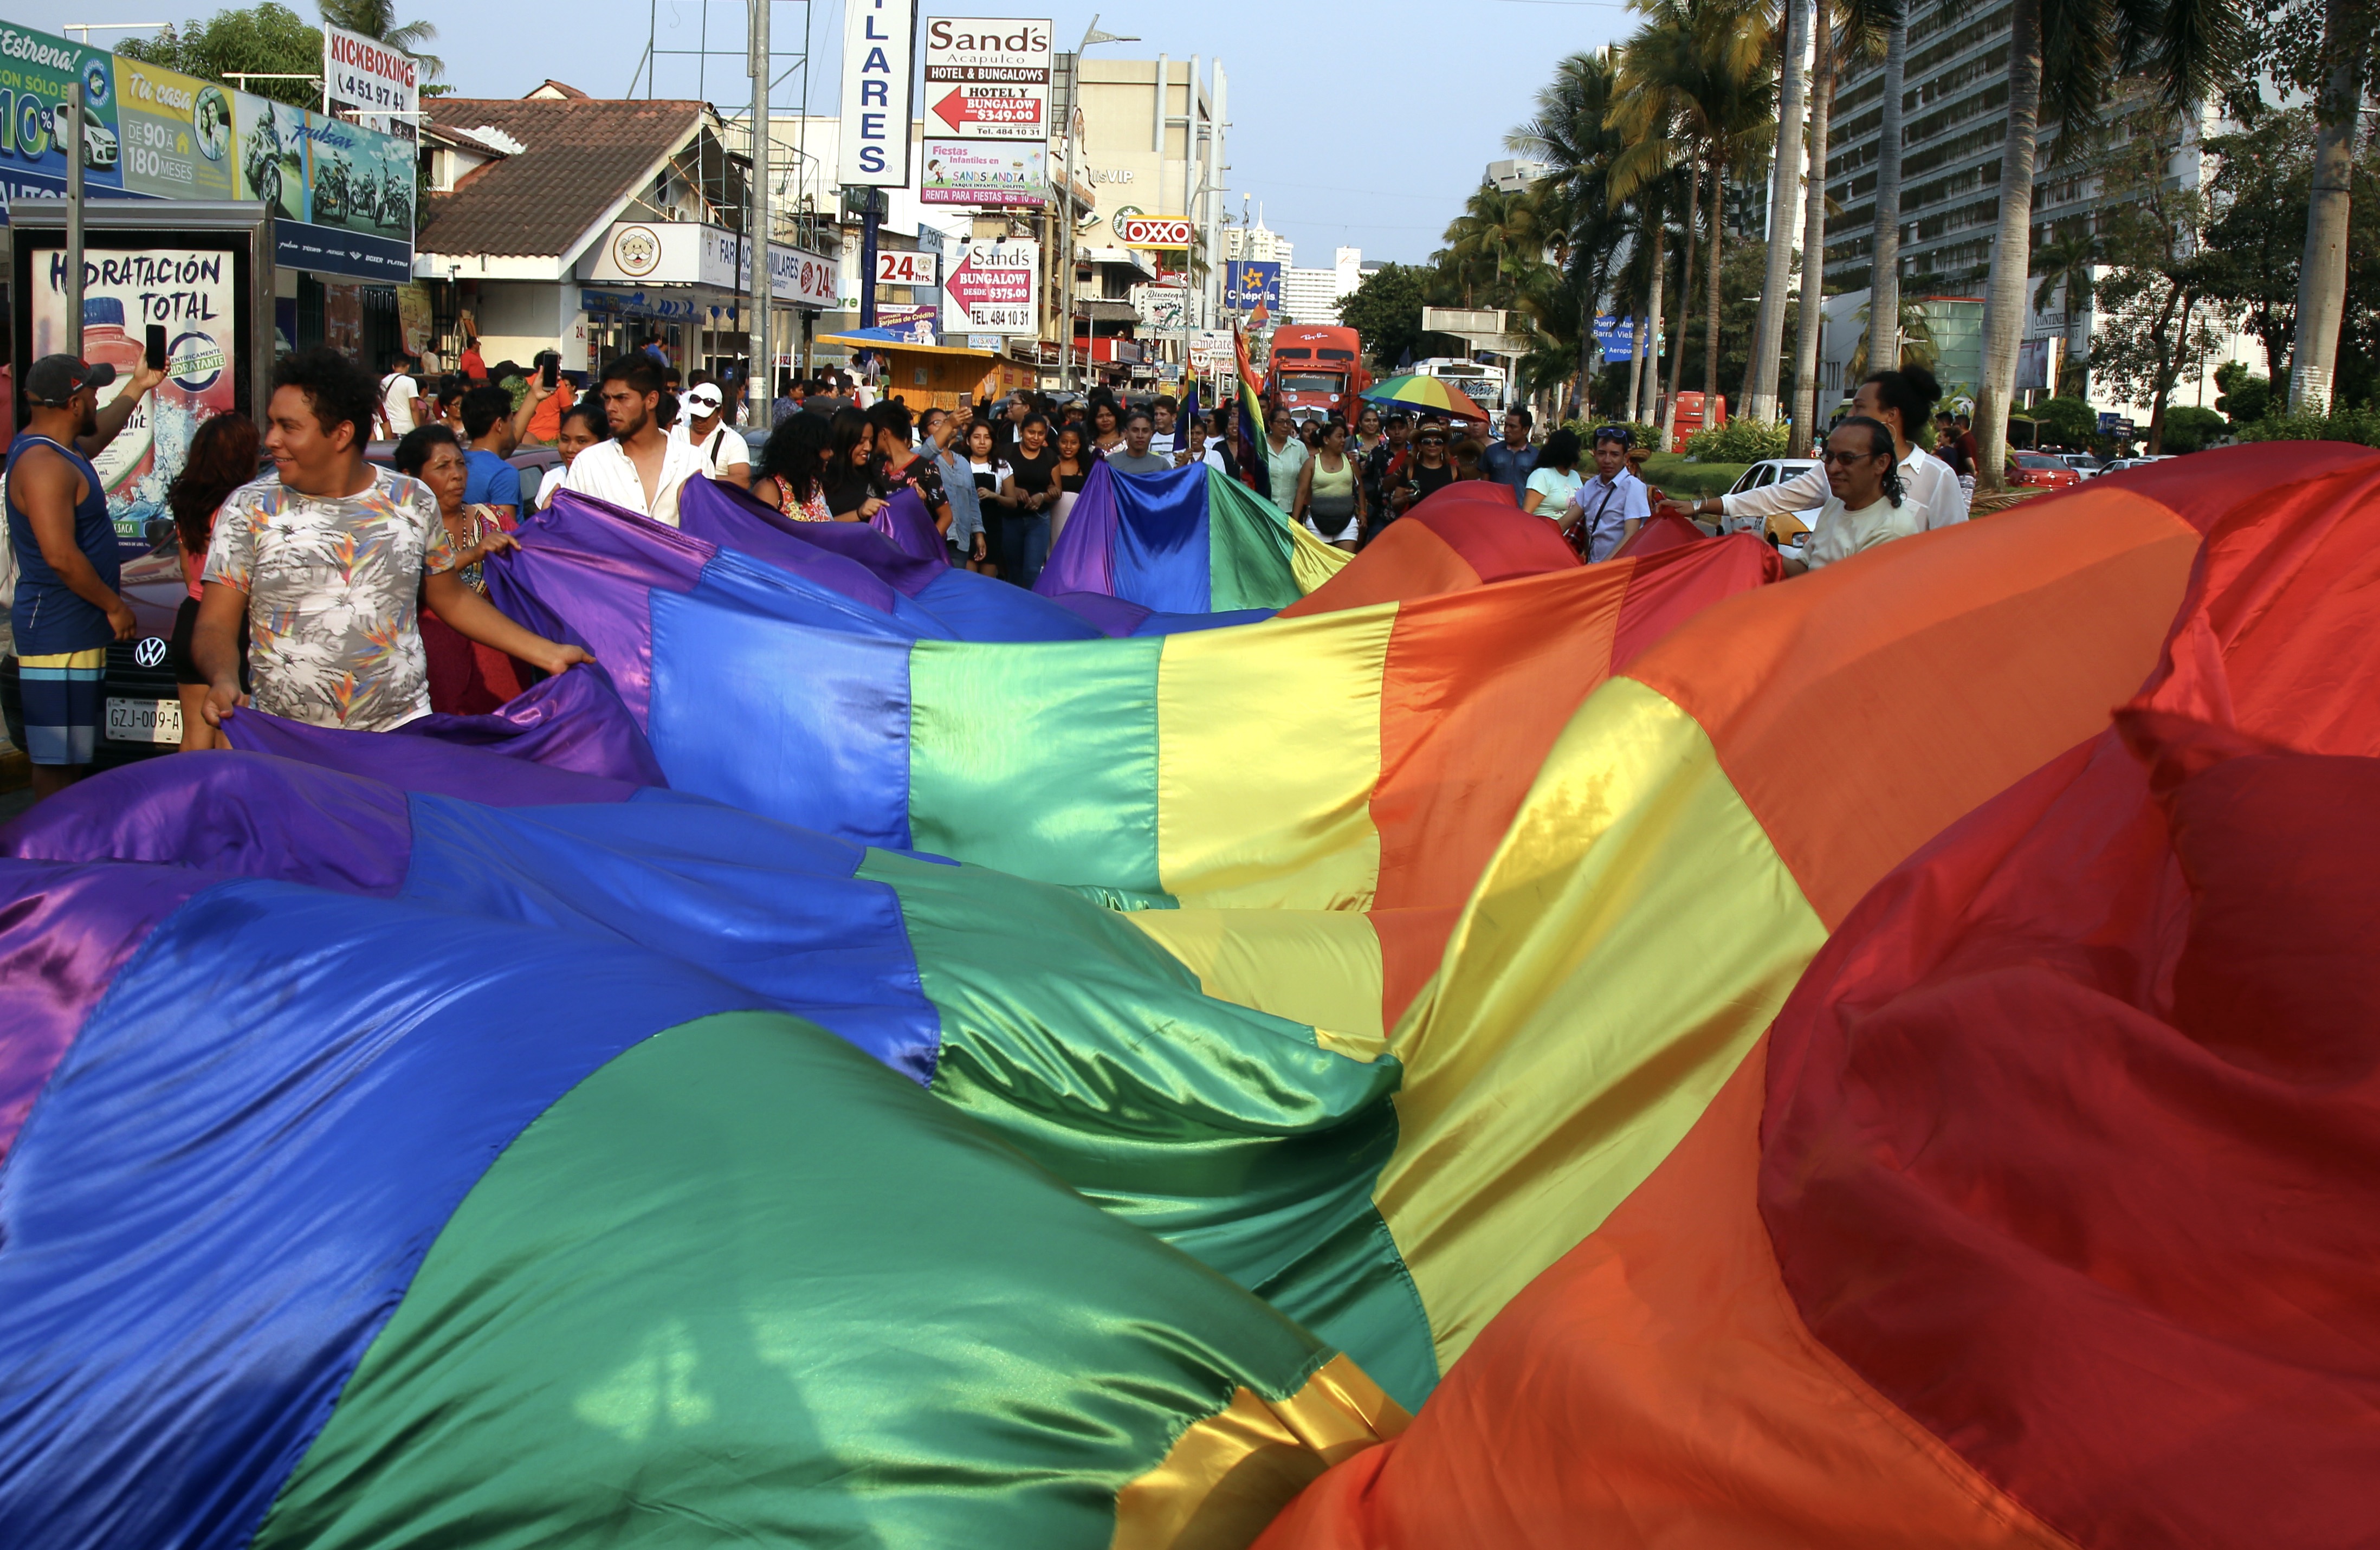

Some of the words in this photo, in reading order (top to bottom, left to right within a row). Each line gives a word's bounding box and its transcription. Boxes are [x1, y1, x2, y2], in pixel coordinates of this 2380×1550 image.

[331, 33, 415, 89] KICKBOXING
[947, 54, 1025, 66] Acapulco
[83, 59, 105, 79] SEGURO
[932, 67, 964, 79] HOTEL
[967, 68, 975, 79] &
[978, 68, 1043, 81] BUNGALOWS
[25, 74, 58, 97] SÓLO
[130, 73, 153, 101] Tu
[156, 85, 192, 111] casa
[346, 76, 355, 95] 4
[358, 79, 373, 102] 51
[376, 86, 390, 107] 97
[969, 87, 1016, 98] HOTEL
[1019, 88, 1029, 98] Y
[90, 87, 111, 107] GRATIS
[967, 99, 1036, 110] BUNGALOW
[977, 108, 1034, 121] $349.00
[128, 124, 142, 141] DE
[144, 122, 165, 148] 90
[166, 134, 173, 148] A
[289, 121, 355, 150] pulsar
[933, 145, 968, 156] Fiestas
[128, 147, 160, 177] 180
[160, 160, 192, 180] MESES
[950, 156, 987, 165] Infantiles
[953, 171, 1025, 183] SANDSLANDIA
[926, 190, 949, 201] RENTA
[952, 191, 971, 201] PARA
[973, 192, 1002, 202] FIESTAS
[1005, 193, 1018, 203] 484
[1128, 222, 1189, 243] OXXO
[365, 255, 384, 263] BOXER
[767, 250, 799, 280] IMILARES
[50, 252, 221, 296] HDRATACIÓN
[879, 255, 915, 281] 24
[915, 273, 933, 282] hrs.
[816, 263, 830, 298] 24
[959, 273, 1027, 285] BUNGALOW
[962, 288, 987, 296] DESDE
[989, 287, 1028, 299] $375.00
[1146, 290, 1185, 301] Discotequ
[138, 290, 220, 325] TOTAL
[878, 317, 902, 327] Tarjetas
[912, 312, 934, 320] Crédito
[971, 311, 988, 325] TEL.
[991, 311, 1005, 326] 484
[1008, 311, 1018, 326] 10
[1020, 311, 1029, 326] 31
[1593, 330, 1613, 338] Barra
[1200, 339, 1234, 350] metate
[171, 348, 221, 364] ENTÍFICAMENTE
[111, 708, 179, 730] GZJ-009-A
